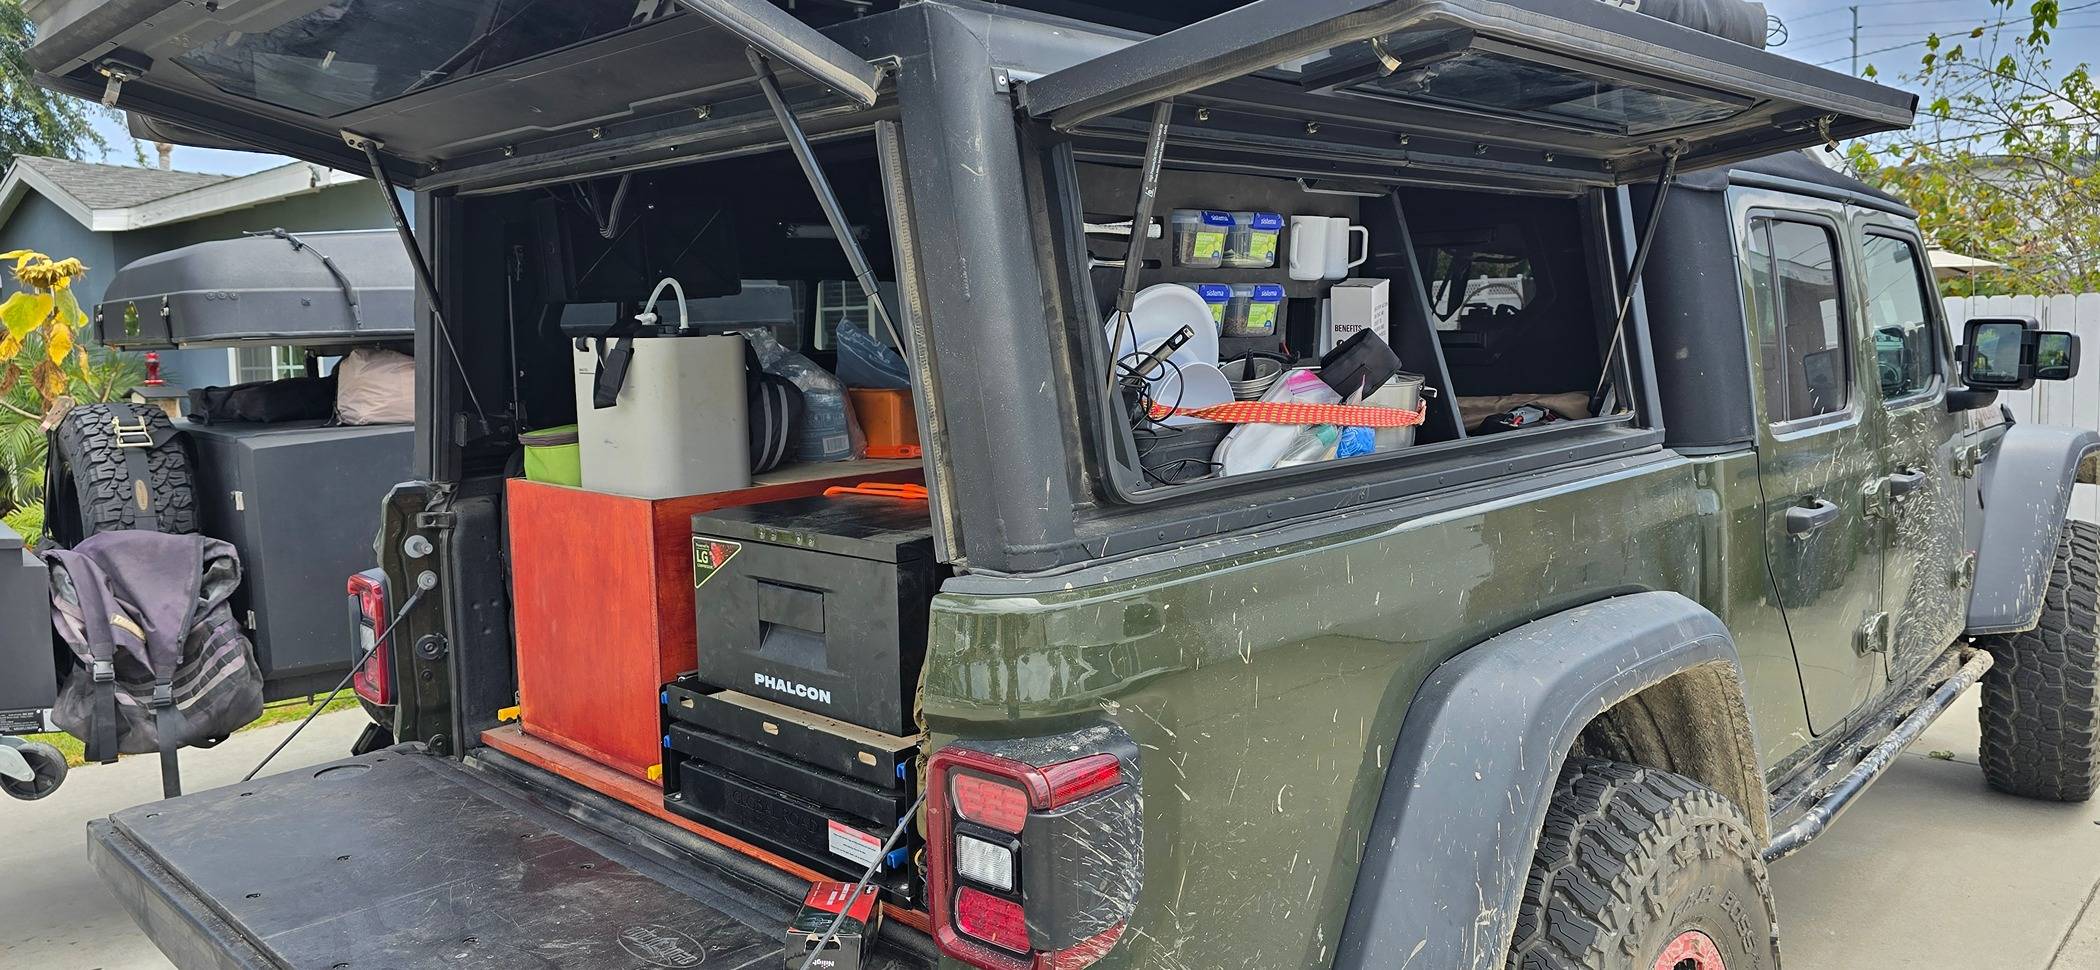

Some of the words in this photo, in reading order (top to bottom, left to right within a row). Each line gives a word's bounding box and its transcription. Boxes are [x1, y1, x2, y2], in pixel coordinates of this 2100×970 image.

[1206, 289, 1224, 297] sistema
[1260, 289, 1278, 297] sistema
[1334, 324, 1362, 333] BENEFITS
[696, 549, 708, 564] LG
[754, 672, 832, 705] PHALCON
[1718, 888, 1755, 954] BOSS
